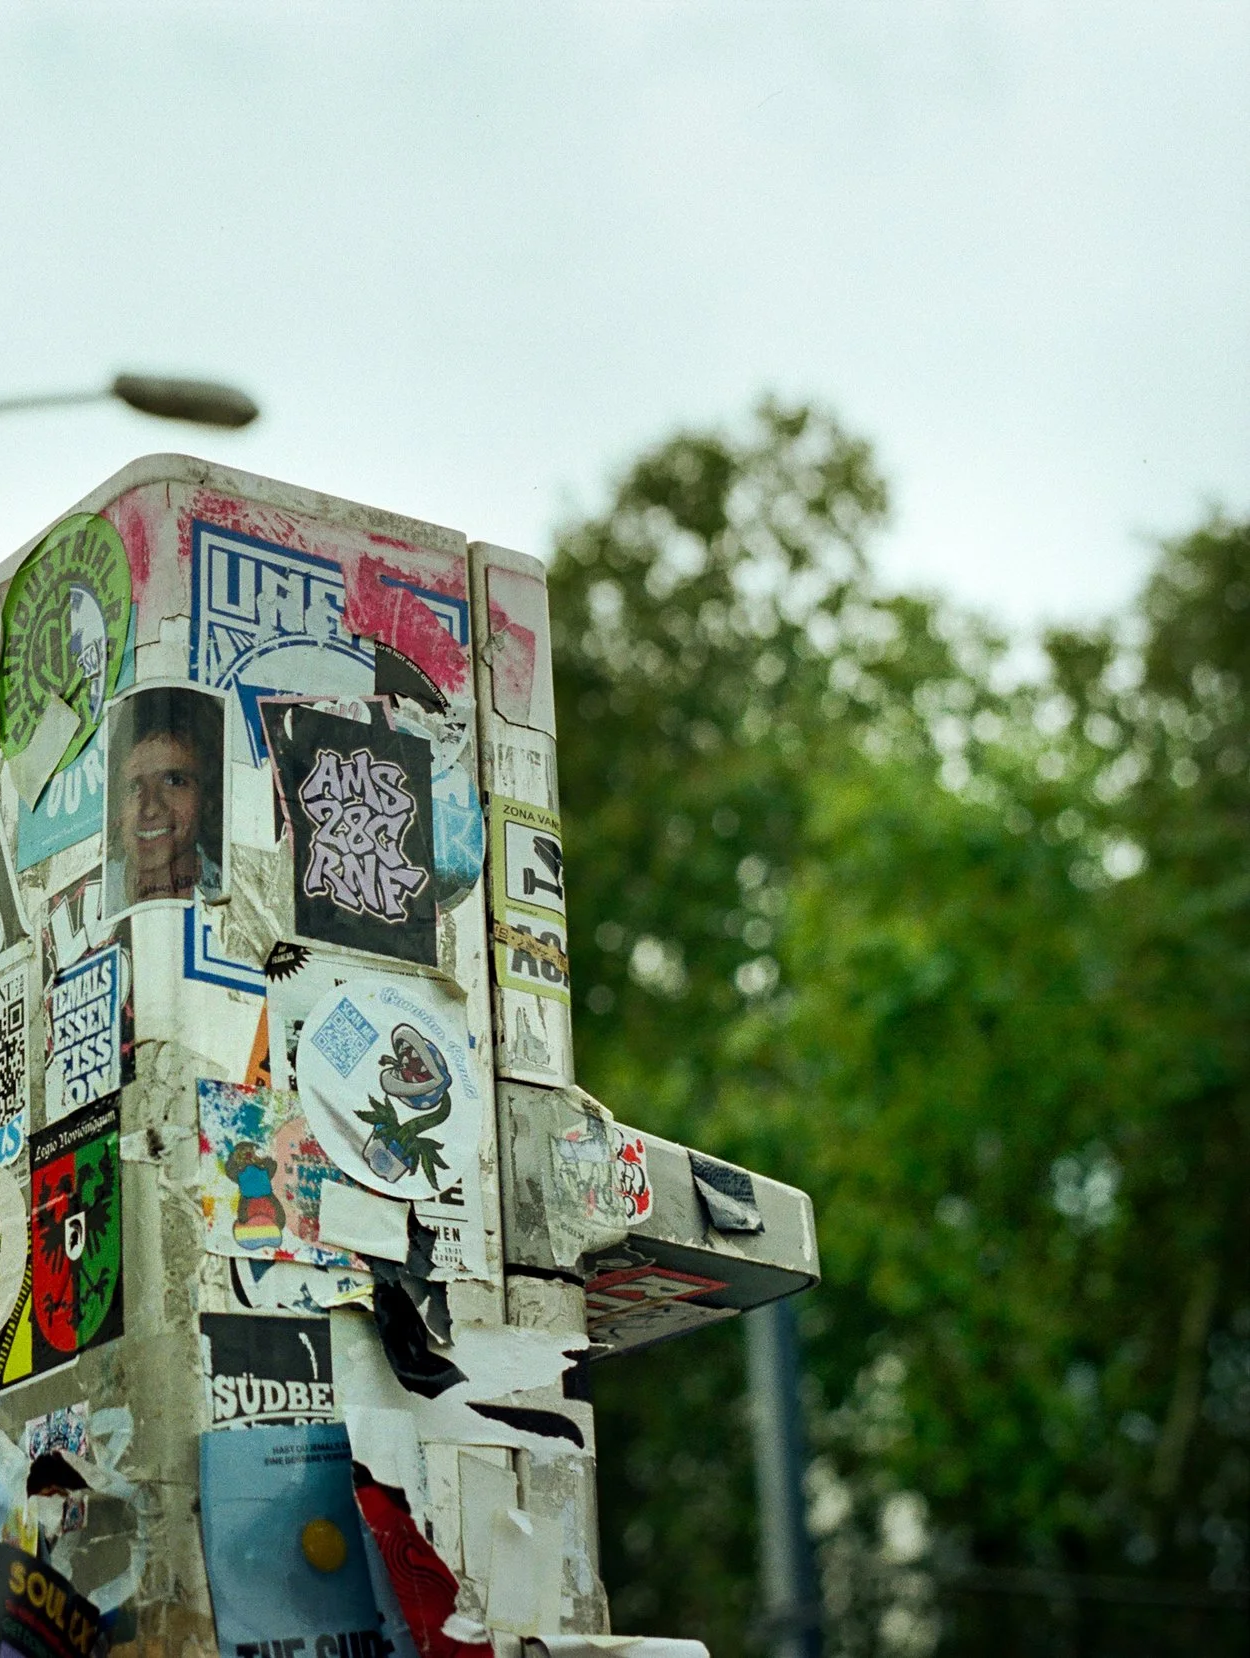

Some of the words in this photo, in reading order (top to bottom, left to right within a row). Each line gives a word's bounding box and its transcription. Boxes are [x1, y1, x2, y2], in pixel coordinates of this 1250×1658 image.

[420, 673, 438, 693] DISCO
[300, 749, 416, 818] AMS
[503, 804, 536, 822] ZONA
[213, 1372, 334, 1420] SÜDBE
